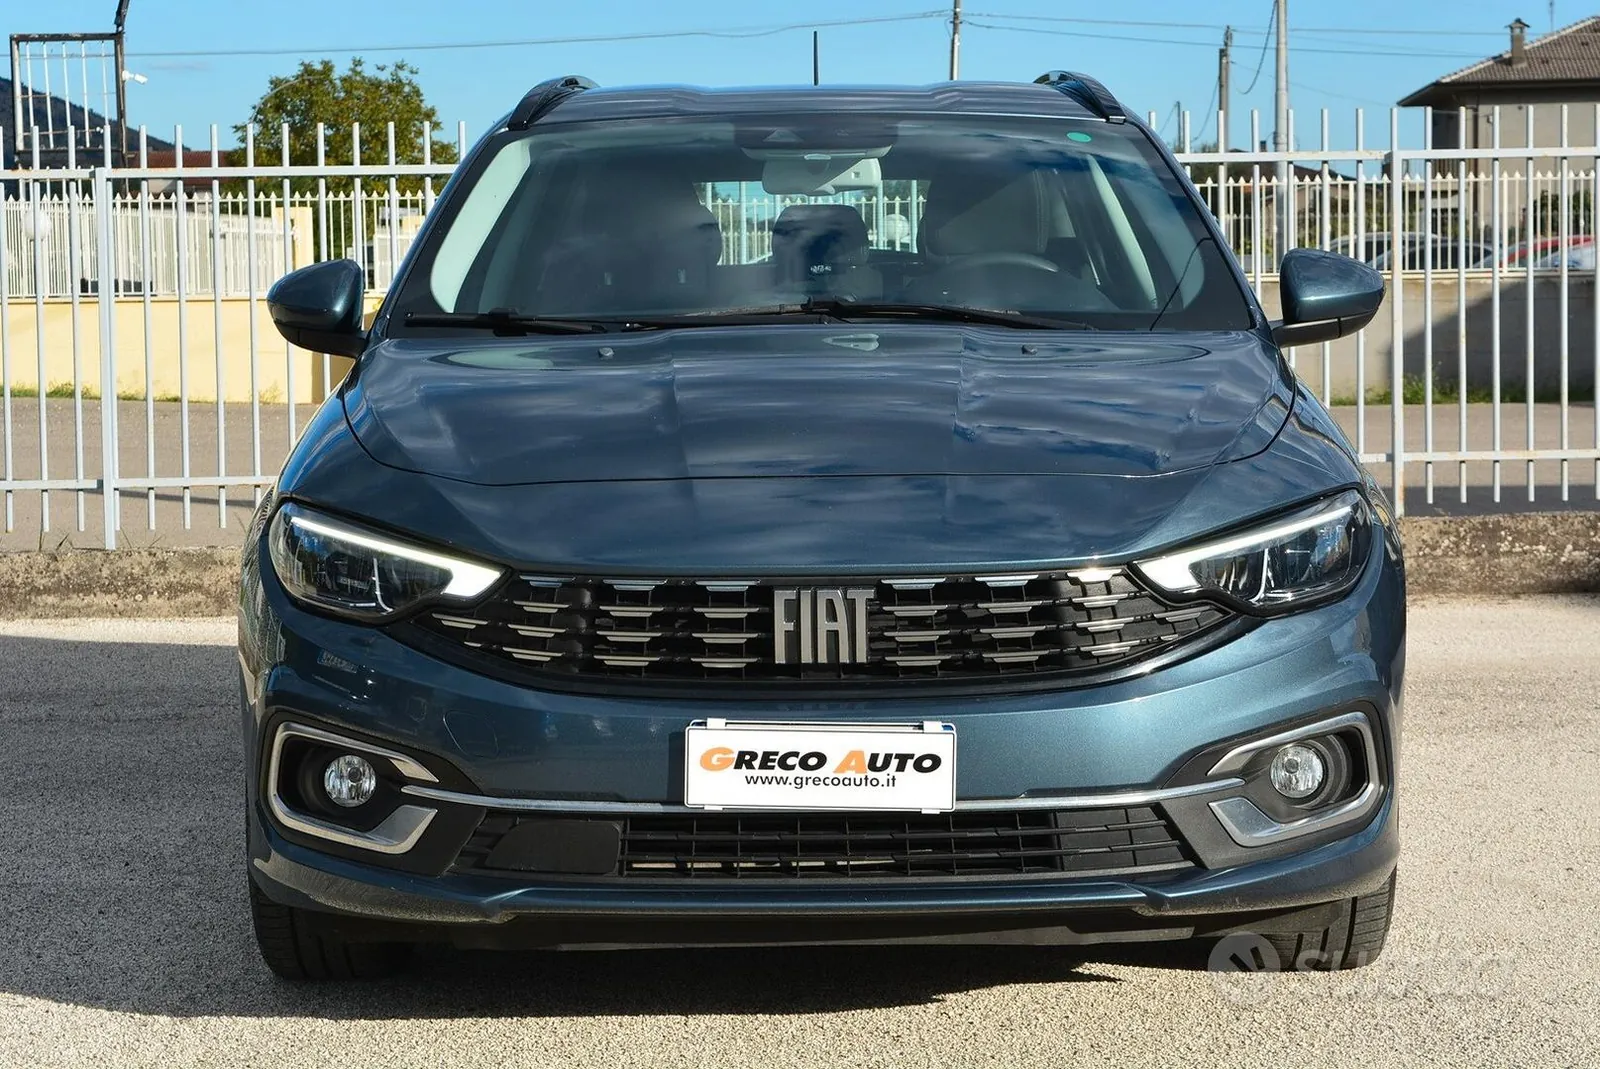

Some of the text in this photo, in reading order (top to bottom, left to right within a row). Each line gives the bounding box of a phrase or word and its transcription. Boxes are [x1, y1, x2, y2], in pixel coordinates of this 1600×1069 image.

[773, 587, 876, 664] FIAT
[699, 746, 943, 774] GRECO AUTO
[745, 773, 897, 789] www.grecoauto.it
